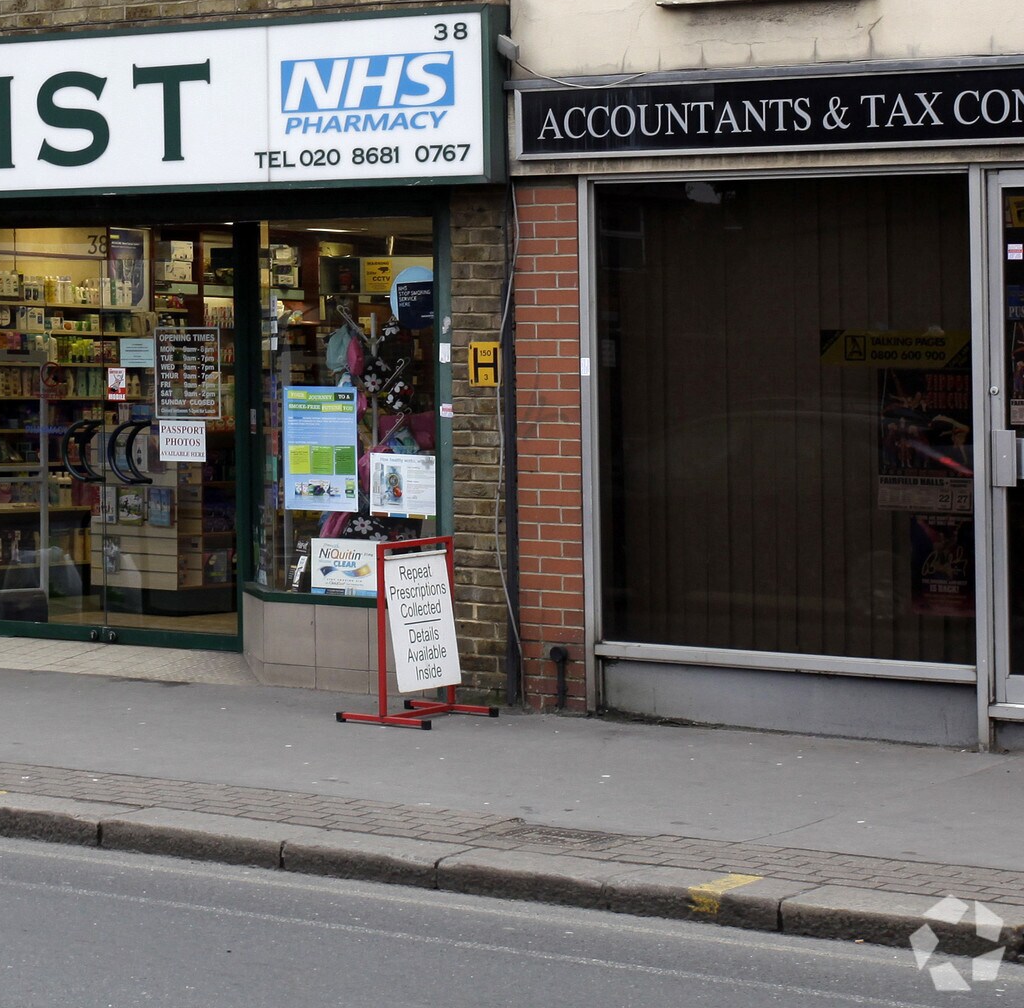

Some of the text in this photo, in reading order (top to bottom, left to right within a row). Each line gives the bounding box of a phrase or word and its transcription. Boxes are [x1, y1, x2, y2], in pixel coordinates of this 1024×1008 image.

[433, 22, 468, 41] 38
[283, 53, 452, 112] NHS
[285, 110, 447, 135] PHARMACY
[537, 97, 812, 141] ACCOUNTANTS
[822, 96, 851, 130] &
[861, 92, 943, 129] TAX
[254, 143, 471, 169] TEL 020 8681 0767
[88, 235, 107, 254] 38
[159, 333, 215, 342] OPENING TIMES
[870, 336, 946, 347] TALKING PAGES
[479, 348, 492, 357] 150
[870, 350, 898, 360] 0800
[901, 350, 922, 360] 600
[925, 351, 946, 360] 900
[474, 347, 498, 383] H
[161, 426, 204, 435] PASSPORT
[165, 438, 201, 446] PHOTOS
[880, 477, 918, 485] FAIRFIELD
[939, 495, 950, 503] 22
[319, 548, 361, 560] NiQuitin
[399, 564, 432, 583] Repeat
[389, 582, 447, 601] Prescriptions
[400, 599, 441, 618] Collected
[409, 627, 440, 643] Details
[407, 644, 447, 663] Available
[415, 664, 442, 680] Inside
